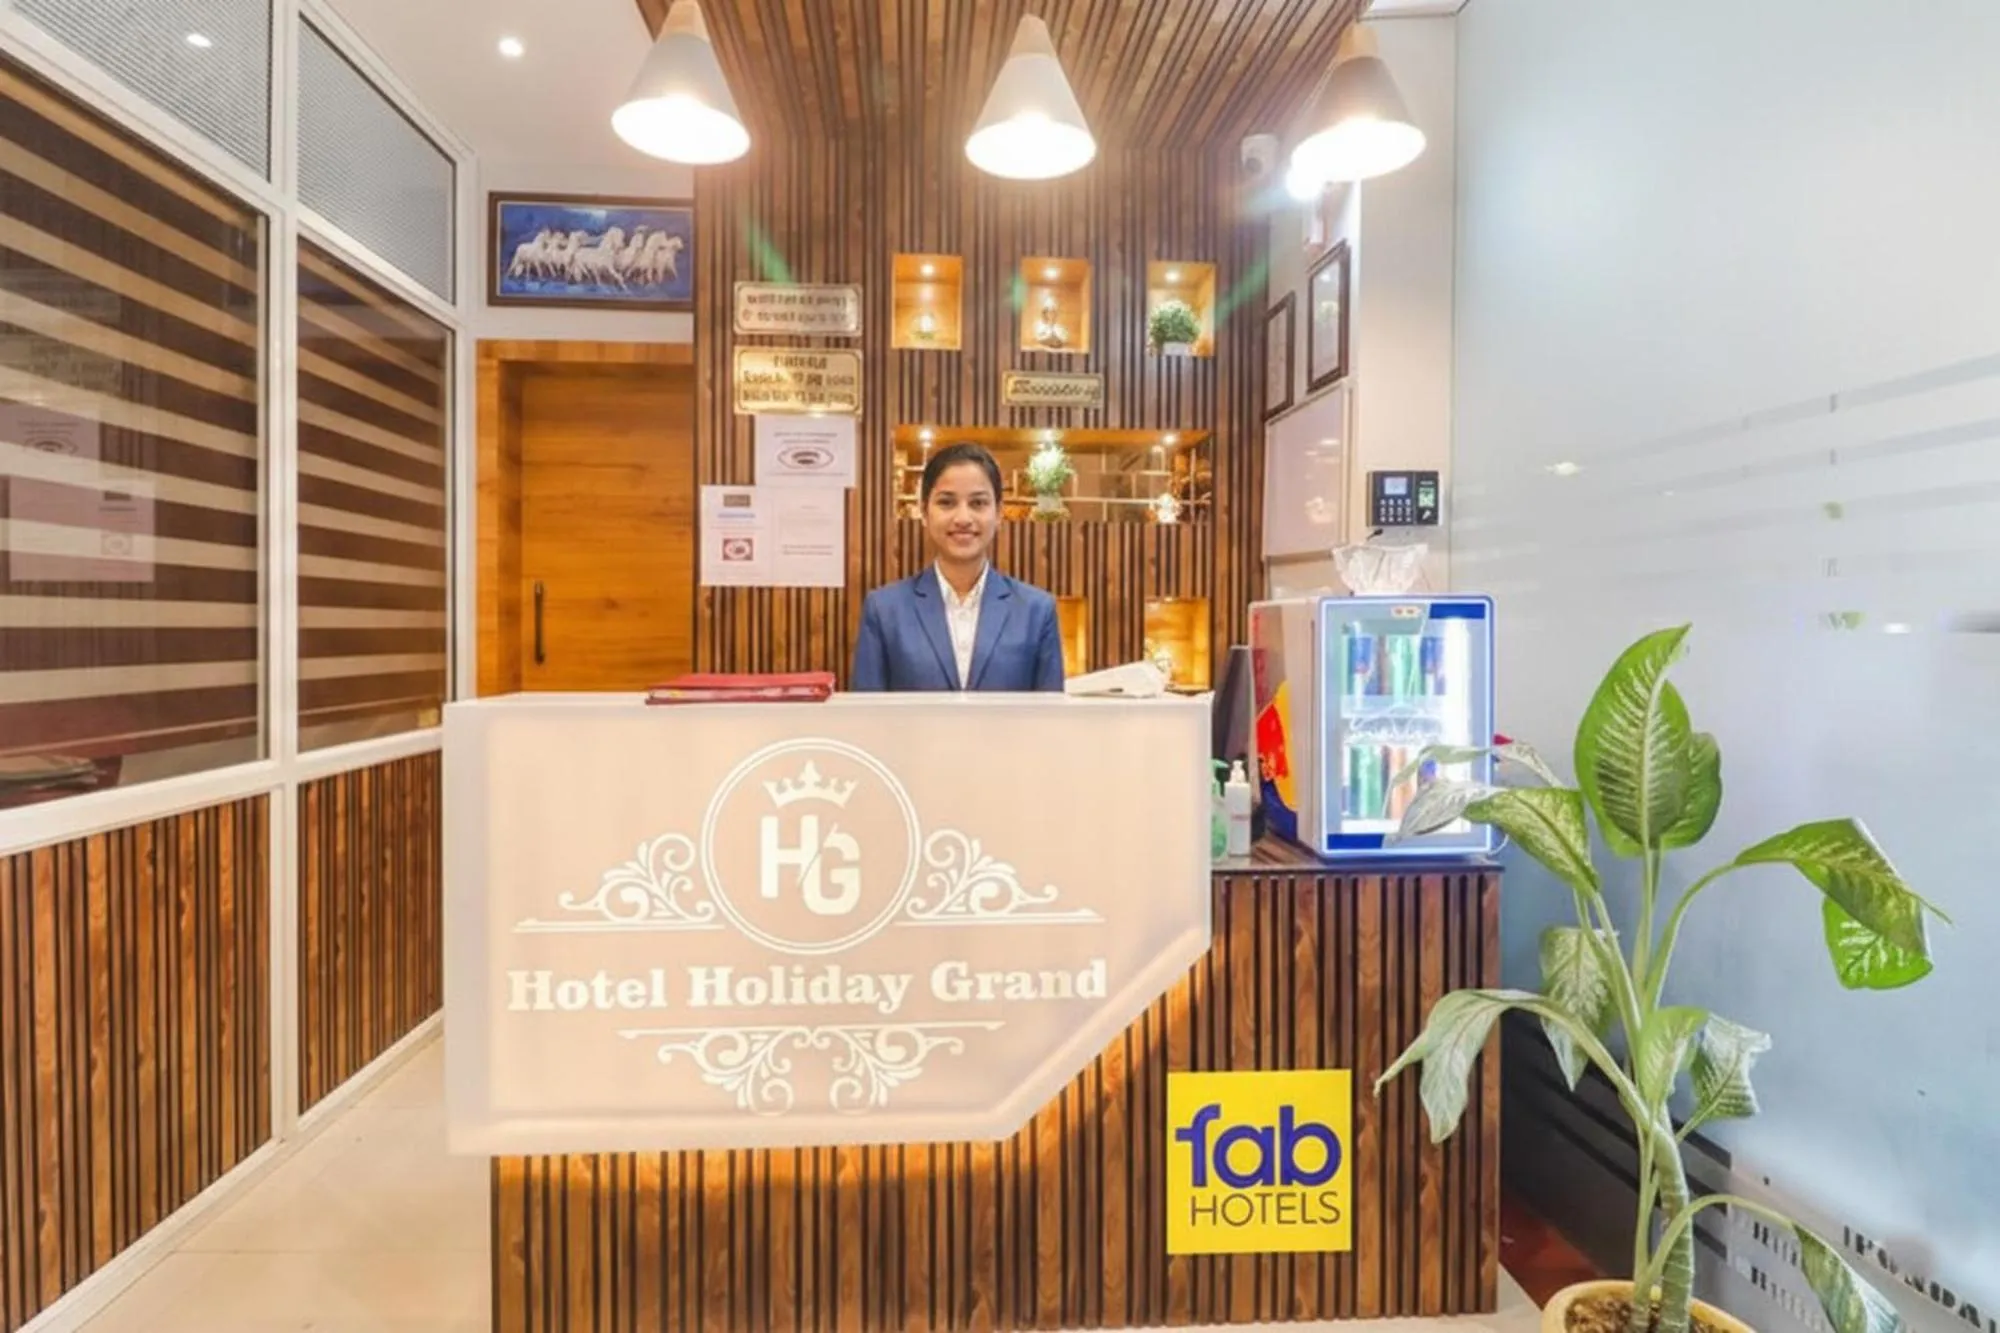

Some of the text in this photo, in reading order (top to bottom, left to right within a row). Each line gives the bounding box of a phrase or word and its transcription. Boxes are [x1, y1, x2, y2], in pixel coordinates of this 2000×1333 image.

[761, 814, 862, 915] HG
[506, 959, 1108, 1014] Hotel Holiday Grand
[1175, 1103, 1342, 1189] fab
[1191, 1191, 1341, 1227] HOTELS
